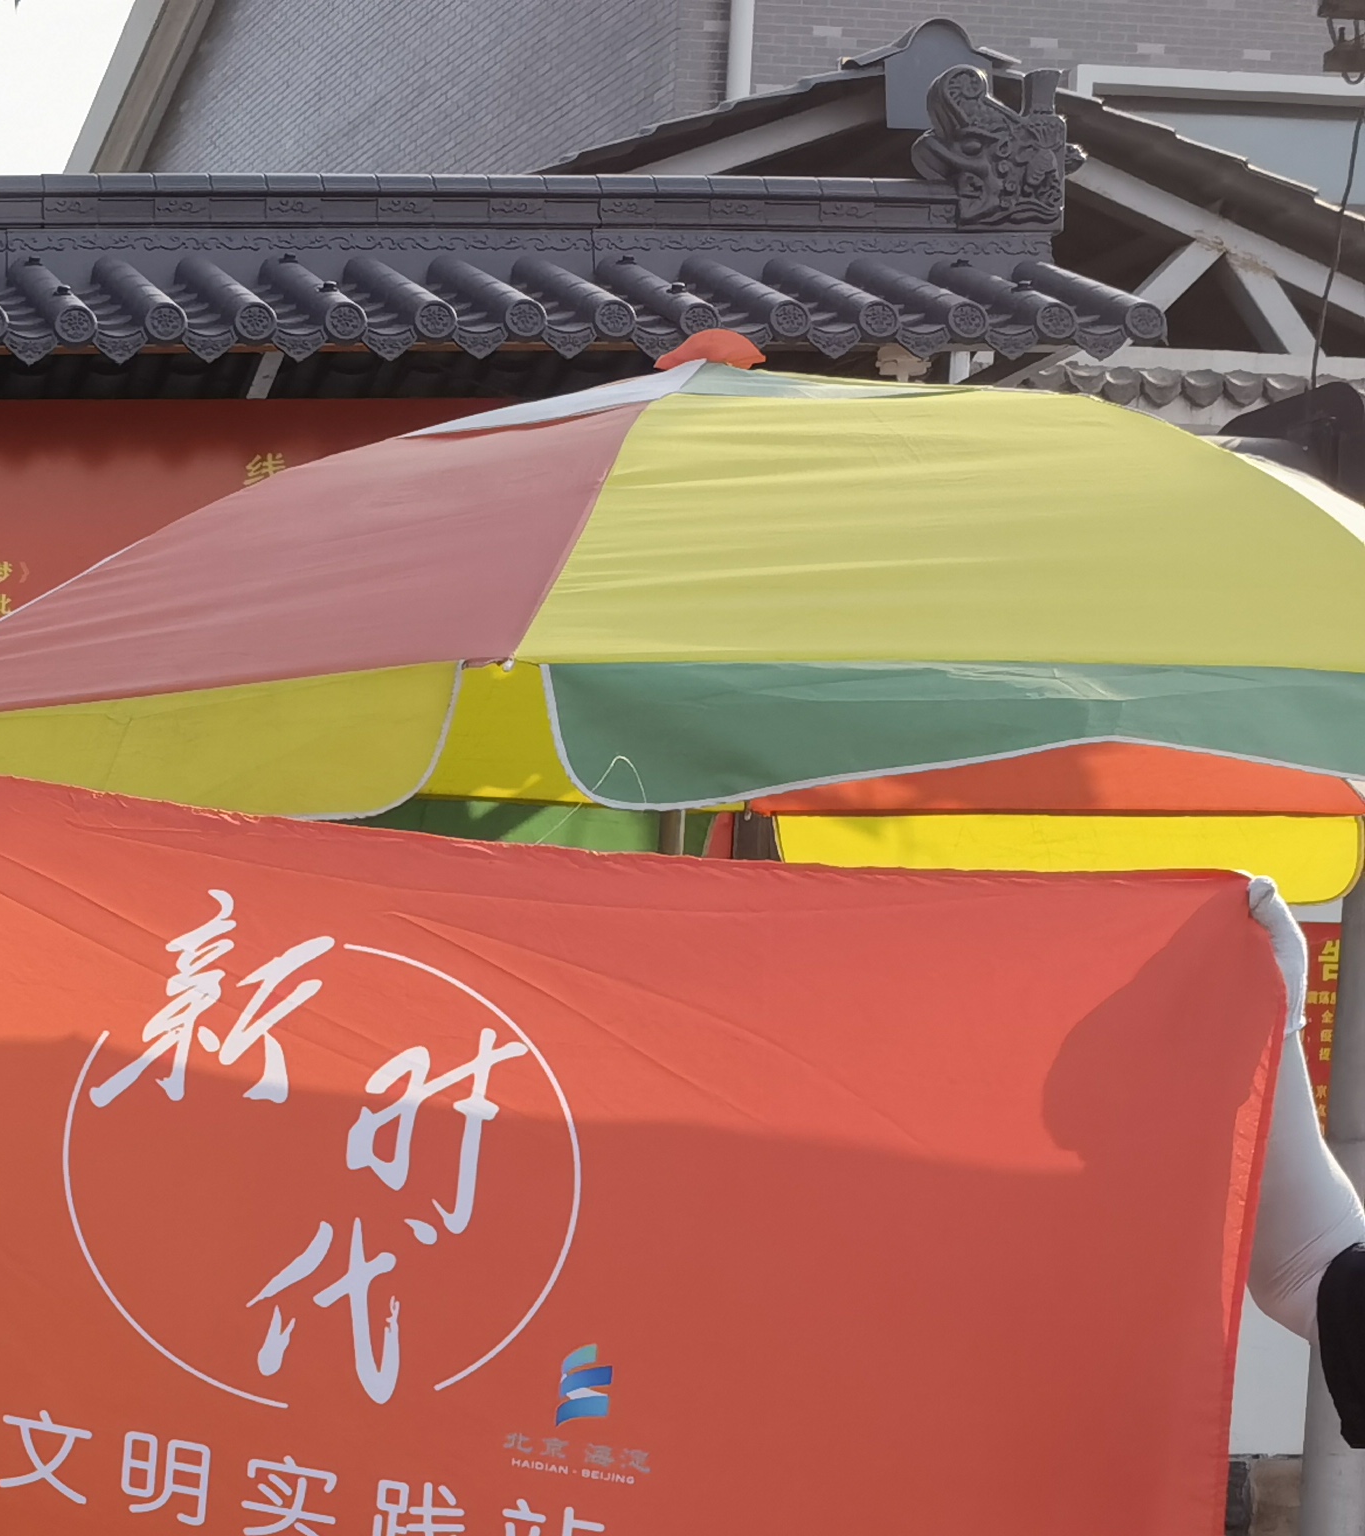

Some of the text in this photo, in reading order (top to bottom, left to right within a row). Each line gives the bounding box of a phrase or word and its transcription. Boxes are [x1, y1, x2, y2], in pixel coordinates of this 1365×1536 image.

[90, 888, 530, 1406] 新时代
[511, 1457, 637, 1486] HAIDIAN BEIJING
